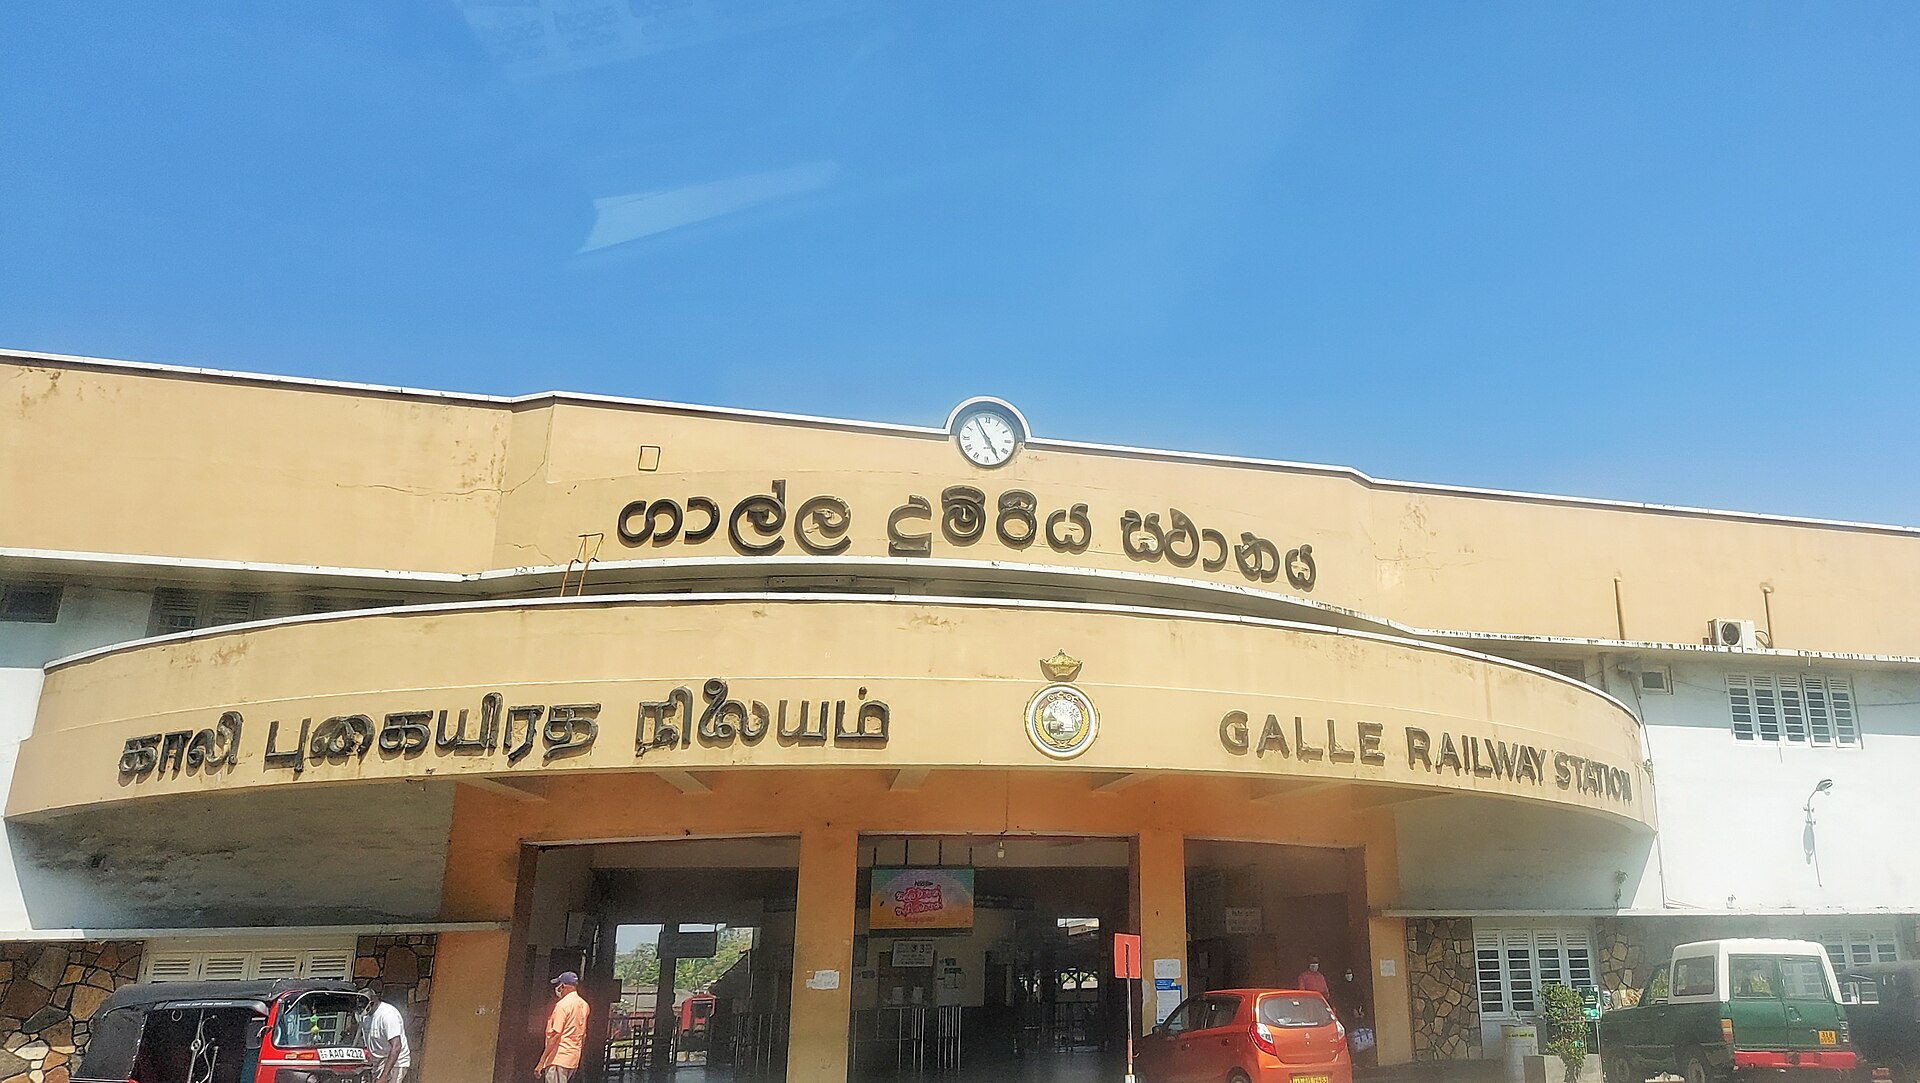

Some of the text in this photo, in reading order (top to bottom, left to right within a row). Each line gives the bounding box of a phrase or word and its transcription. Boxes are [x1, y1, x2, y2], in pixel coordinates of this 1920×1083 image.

[617, 479, 851, 556] ගාල්ල
[887, 485, 1092, 557] දුම්රිය
[118, 678, 890, 785] காலி புகையிரத நிலையம்
[1219, 709, 1633, 806] GALLE RAILWAY STATION
